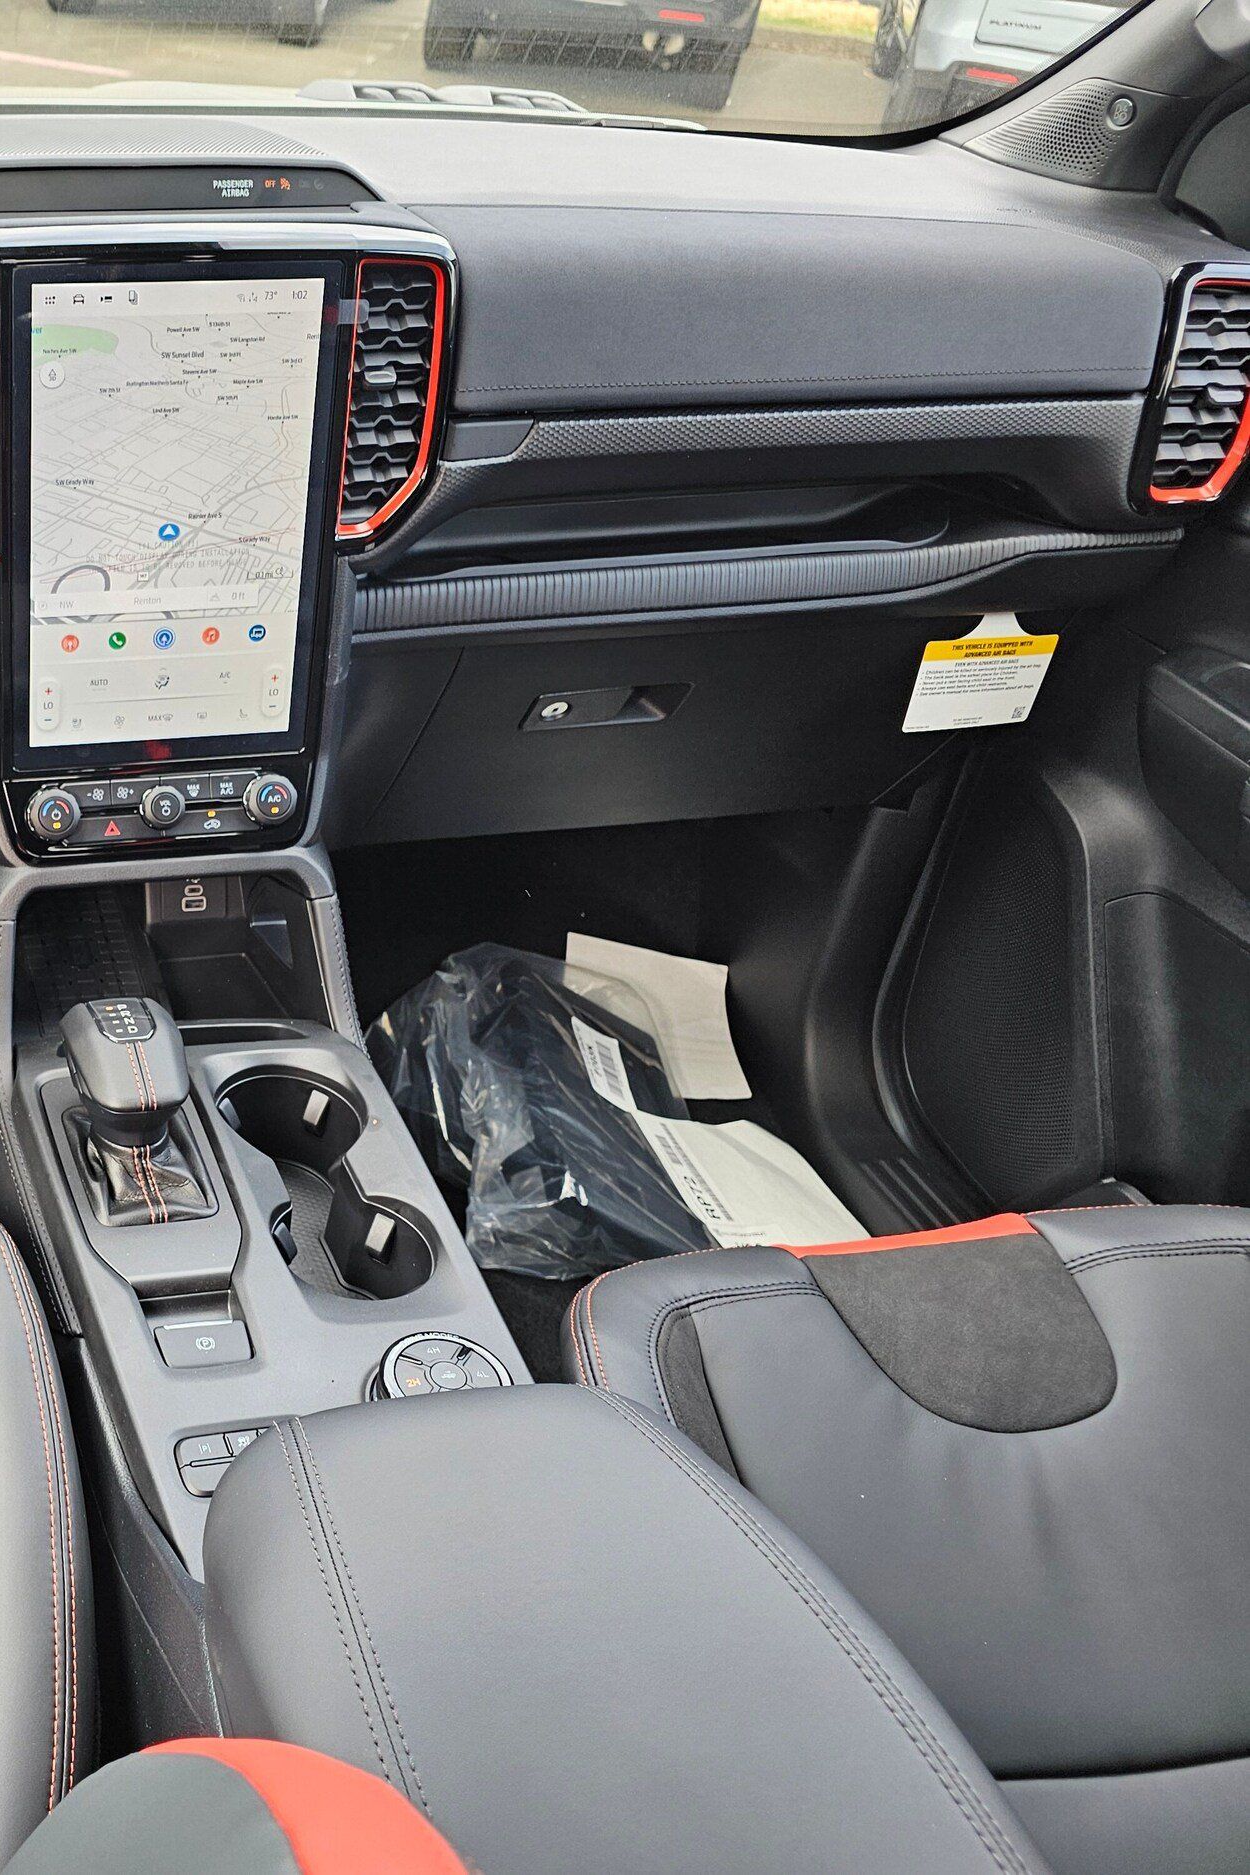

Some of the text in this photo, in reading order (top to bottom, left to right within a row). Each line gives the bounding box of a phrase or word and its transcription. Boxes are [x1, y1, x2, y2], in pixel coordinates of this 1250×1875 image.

[989, 19, 1042, 31] PLATINUM
[213, 179, 276, 189] PASSENGER OFF
[221, 188, 250, 198] AIRBAG
[292, 291, 308, 299] 1:02
[171, 351, 191, 359] Sunset
[60, 601, 74, 609] NW
[43, 702, 54, 710] LO
[220, 787, 234, 795] A/C
[267, 795, 282, 803] A/C
[127, 1025, 138, 1033] D
[427, 1346, 440, 1354] 4H
[477, 1370, 489, 1378] 4L
[406, 1378, 421, 1388] 2H
